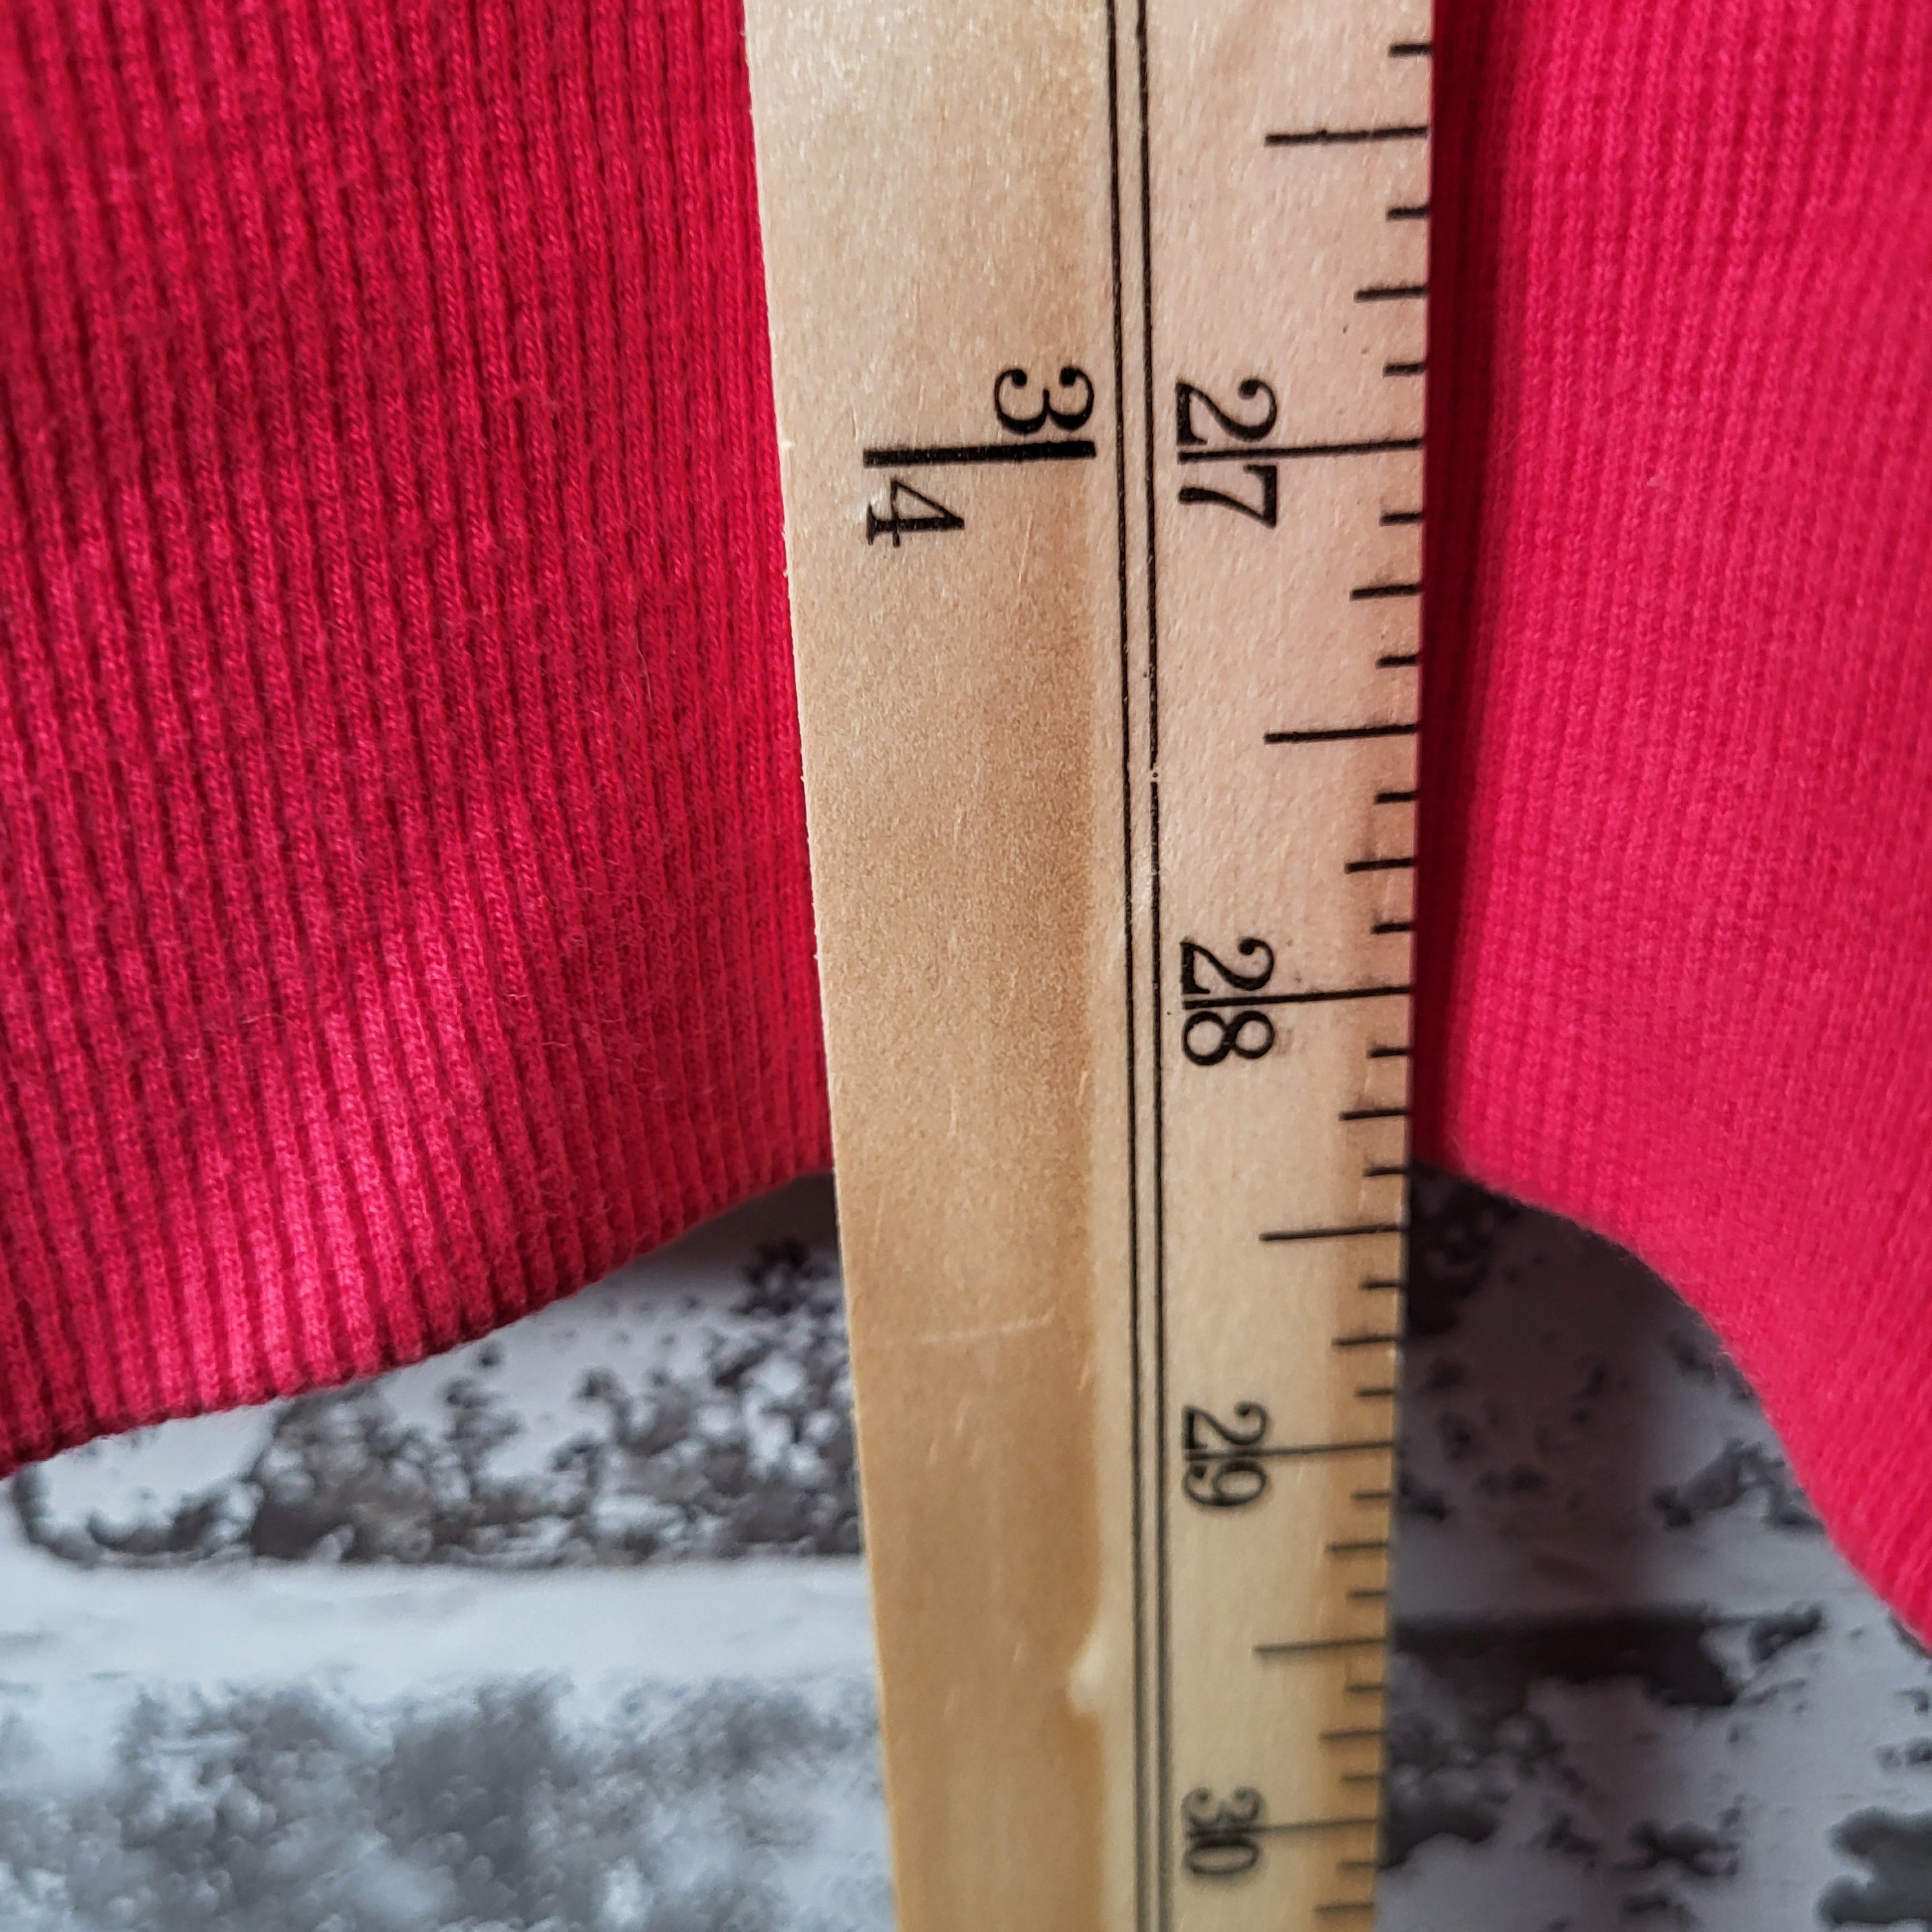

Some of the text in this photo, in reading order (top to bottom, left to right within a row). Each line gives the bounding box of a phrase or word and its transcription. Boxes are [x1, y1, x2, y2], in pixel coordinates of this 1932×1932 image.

[1175, 378, 1278, 528] 27
[1180, 937, 1275, 1066] 28
[1182, 1401, 1269, 1508] 29
[1181, 1787, 1262, 1876] 30
